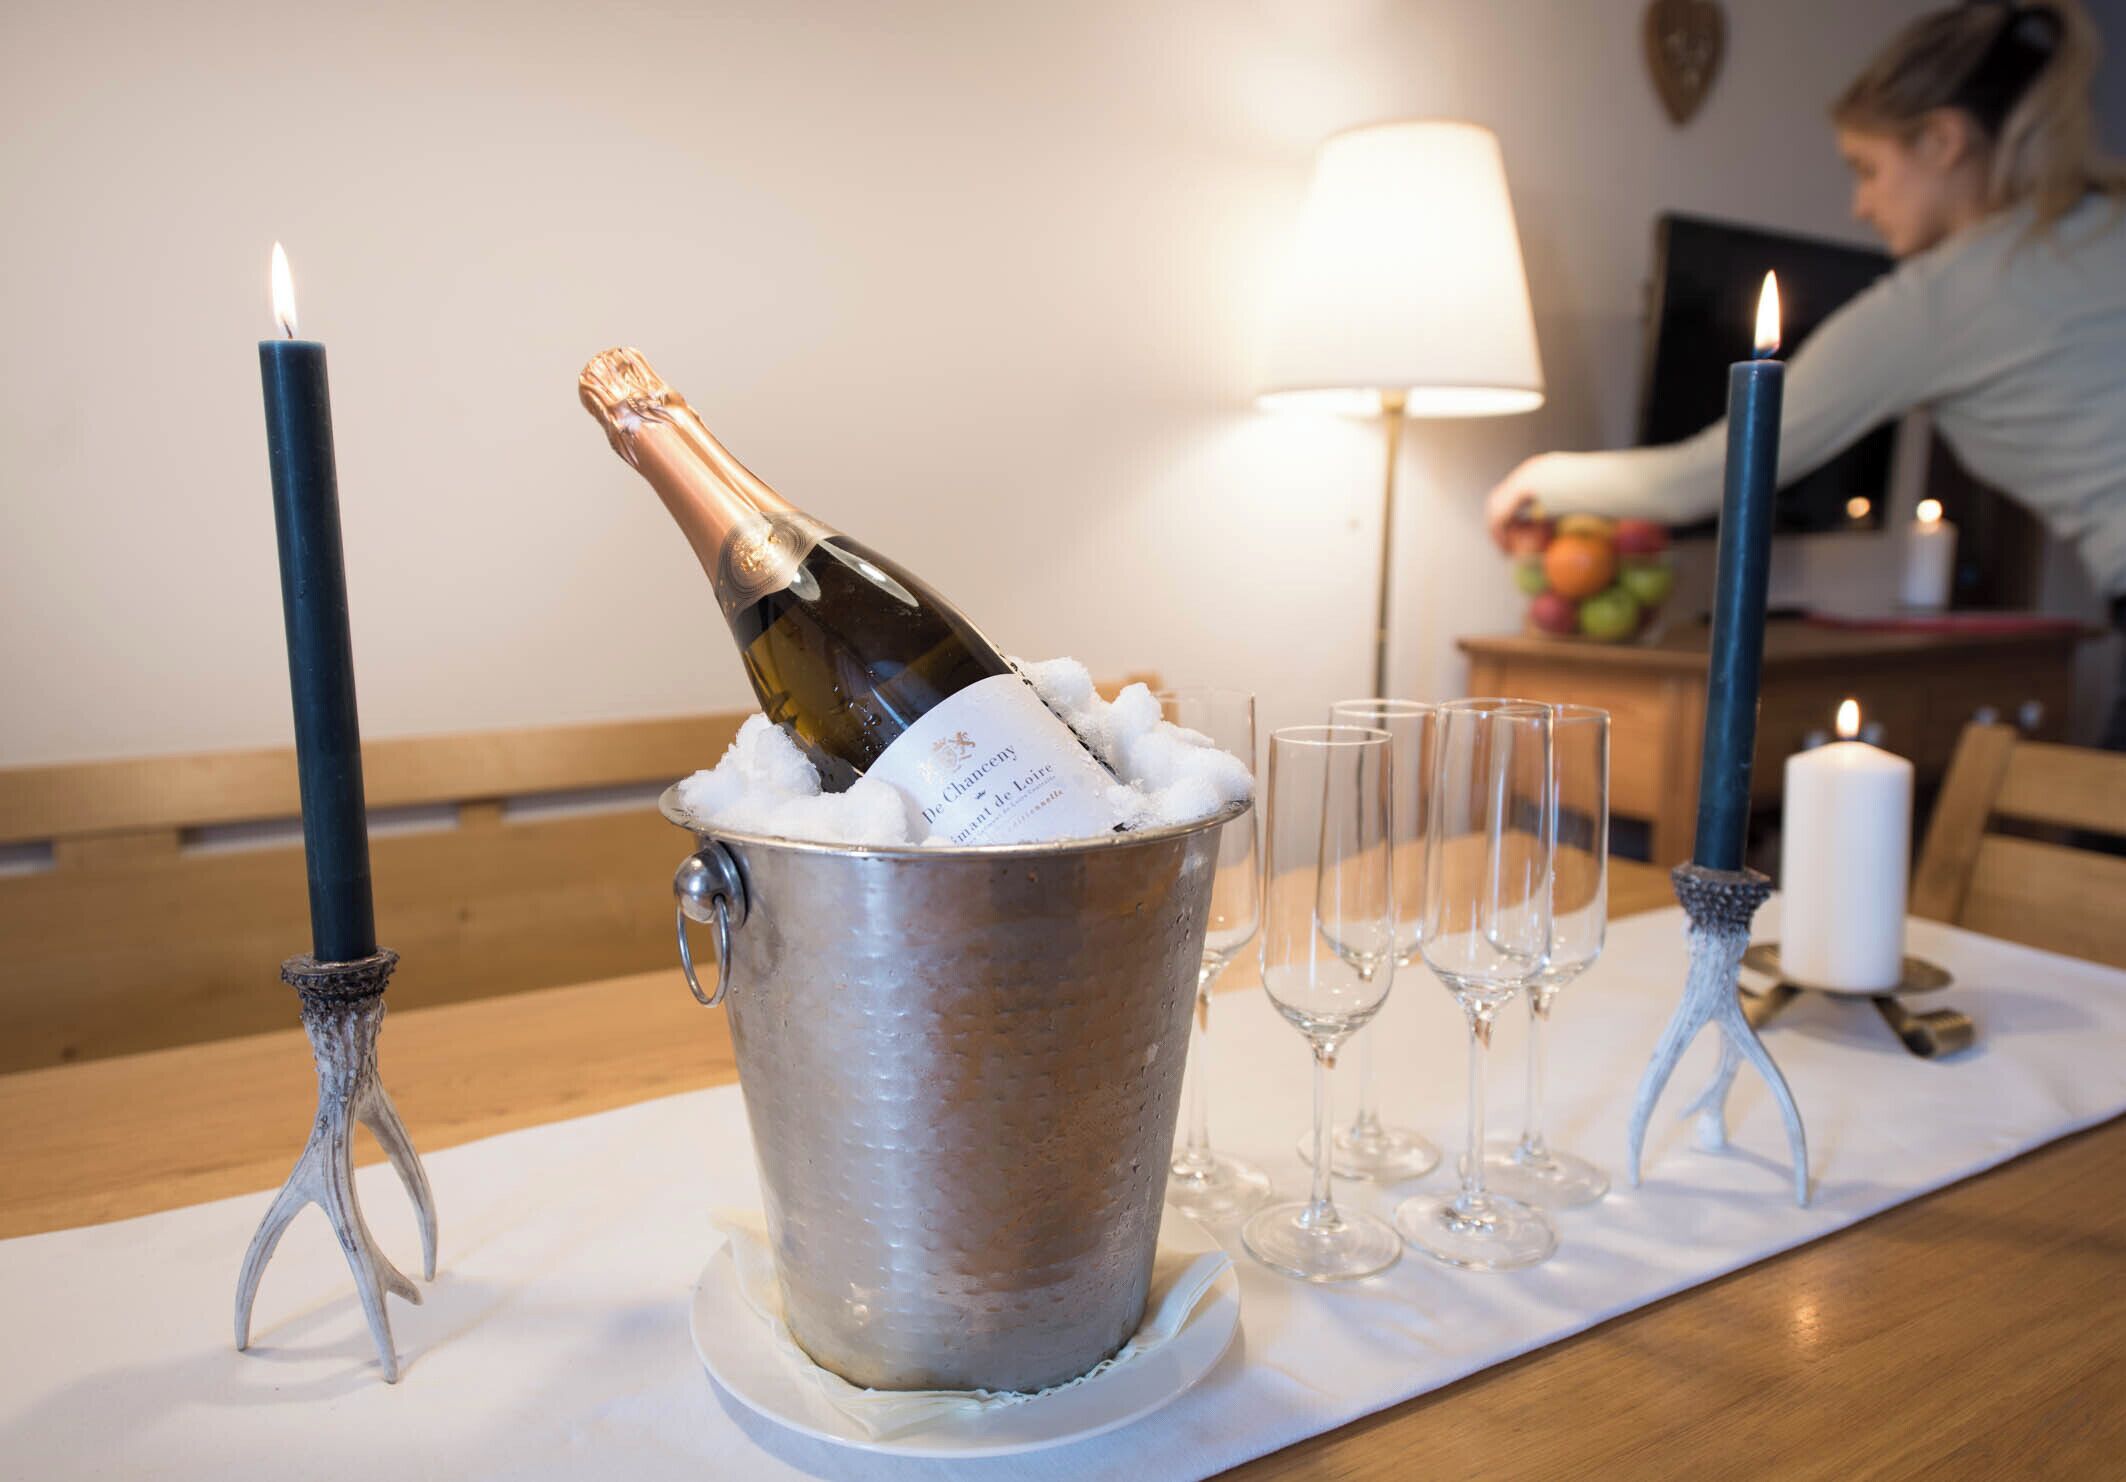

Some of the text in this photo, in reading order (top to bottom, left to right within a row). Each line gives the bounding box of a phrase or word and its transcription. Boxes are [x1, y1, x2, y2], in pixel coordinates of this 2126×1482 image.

[922, 803, 945, 824] De
[943, 745, 1017, 803] Chanceny
[994, 791, 1012, 808] de
[1013, 764, 1054, 791] Loire
